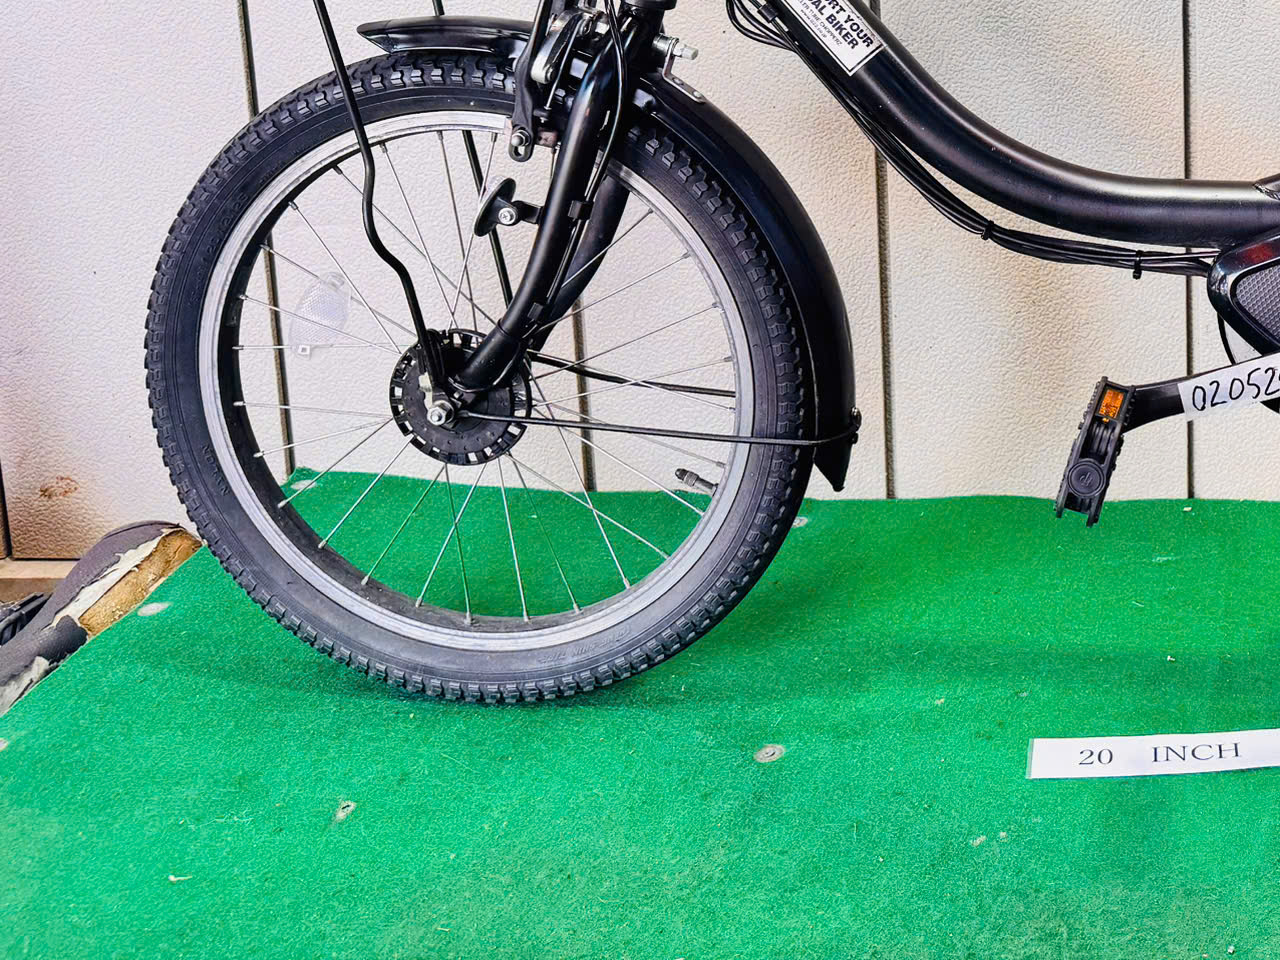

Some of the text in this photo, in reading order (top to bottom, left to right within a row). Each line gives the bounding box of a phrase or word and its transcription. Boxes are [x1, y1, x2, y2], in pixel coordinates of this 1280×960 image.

[825, 14, 860, 49] BIKER
[844, 14, 874, 48] YOUR
[1078, 742, 1241, 766] 20 INCH
